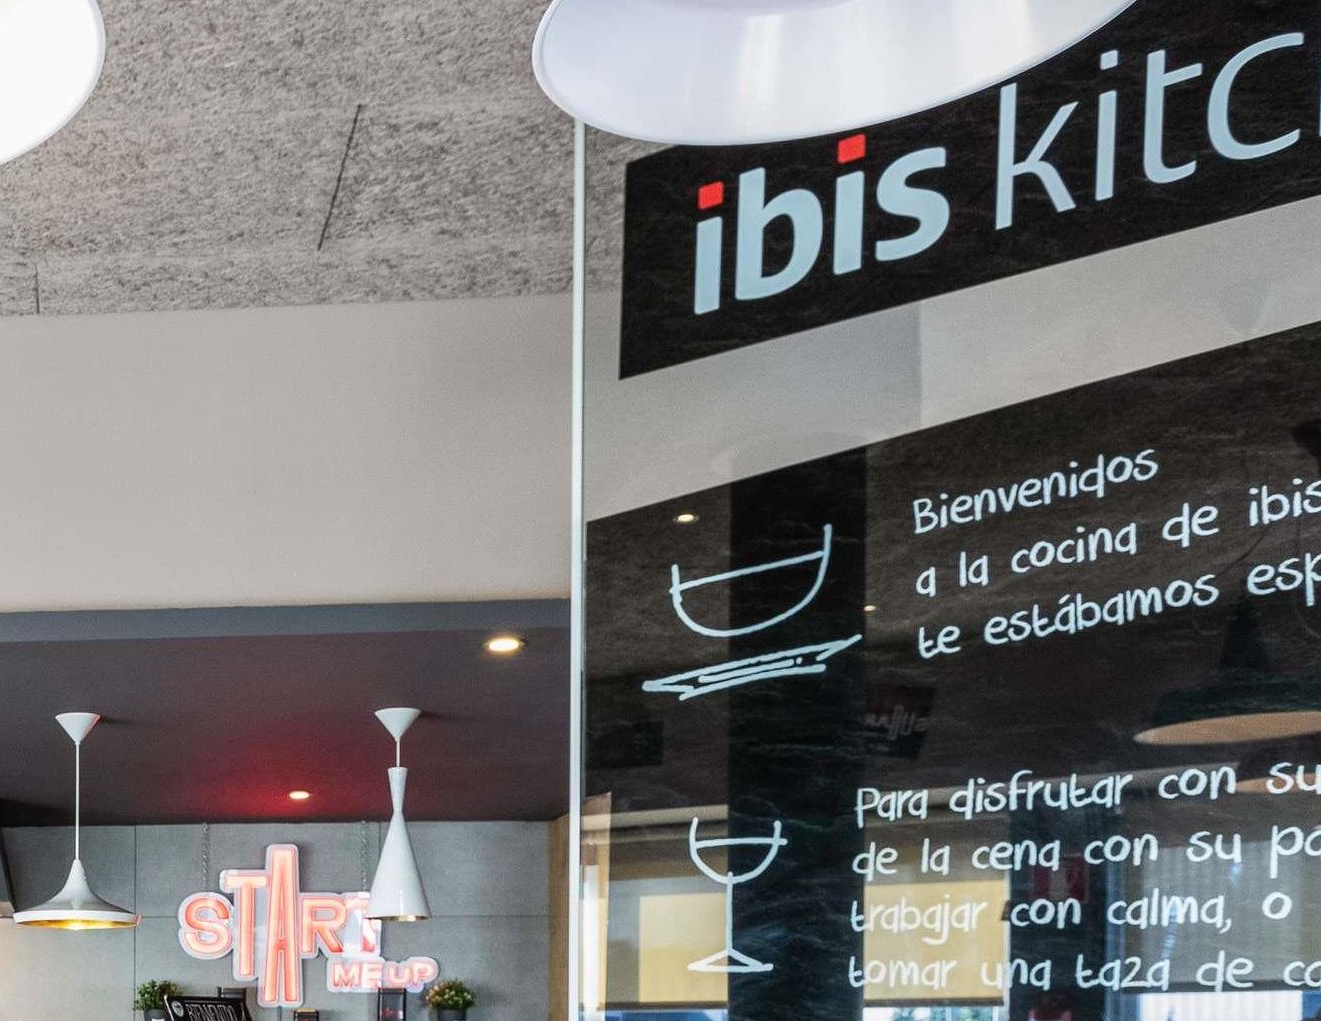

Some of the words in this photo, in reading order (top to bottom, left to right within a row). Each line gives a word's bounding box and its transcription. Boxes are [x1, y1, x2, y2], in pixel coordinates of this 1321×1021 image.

[694, 134, 951, 315] ibis
[995, 31, 1321, 230] kitc
[912, 449, 1159, 535] Bienvenidos
[915, 566, 936, 597] a
[958, 551, 989, 587] la
[1011, 522, 1138, 574] cocina
[1162, 502, 1220, 548] de
[1249, 477, 1321, 527] ibis
[918, 626, 961, 659] te
[984, 573, 1220, 645] estábamos
[854, 787, 929, 828] Para
[949, 769, 1133, 821] disfrutar
[1158, 766, 1237, 800] con
[1266, 762, 1321, 795] su
[852, 841, 898, 881] de
[921, 838, 951, 875] la
[972, 840, 1061, 872] cena
[1084, 835, 1159, 867] con
[1186, 831, 1242, 863] su
[850, 894, 988, 945] trabajar
[1011, 898, 1081, 929] con
[1107, 888, 1232, 934] calma,
[1262, 892, 1292, 920] o
[333, 962, 382, 988] ME
[388, 960, 437, 985] UP
[848, 956, 957, 990] tomar
[981, 958, 1052, 991] una
[1196, 950, 1255, 993] de
